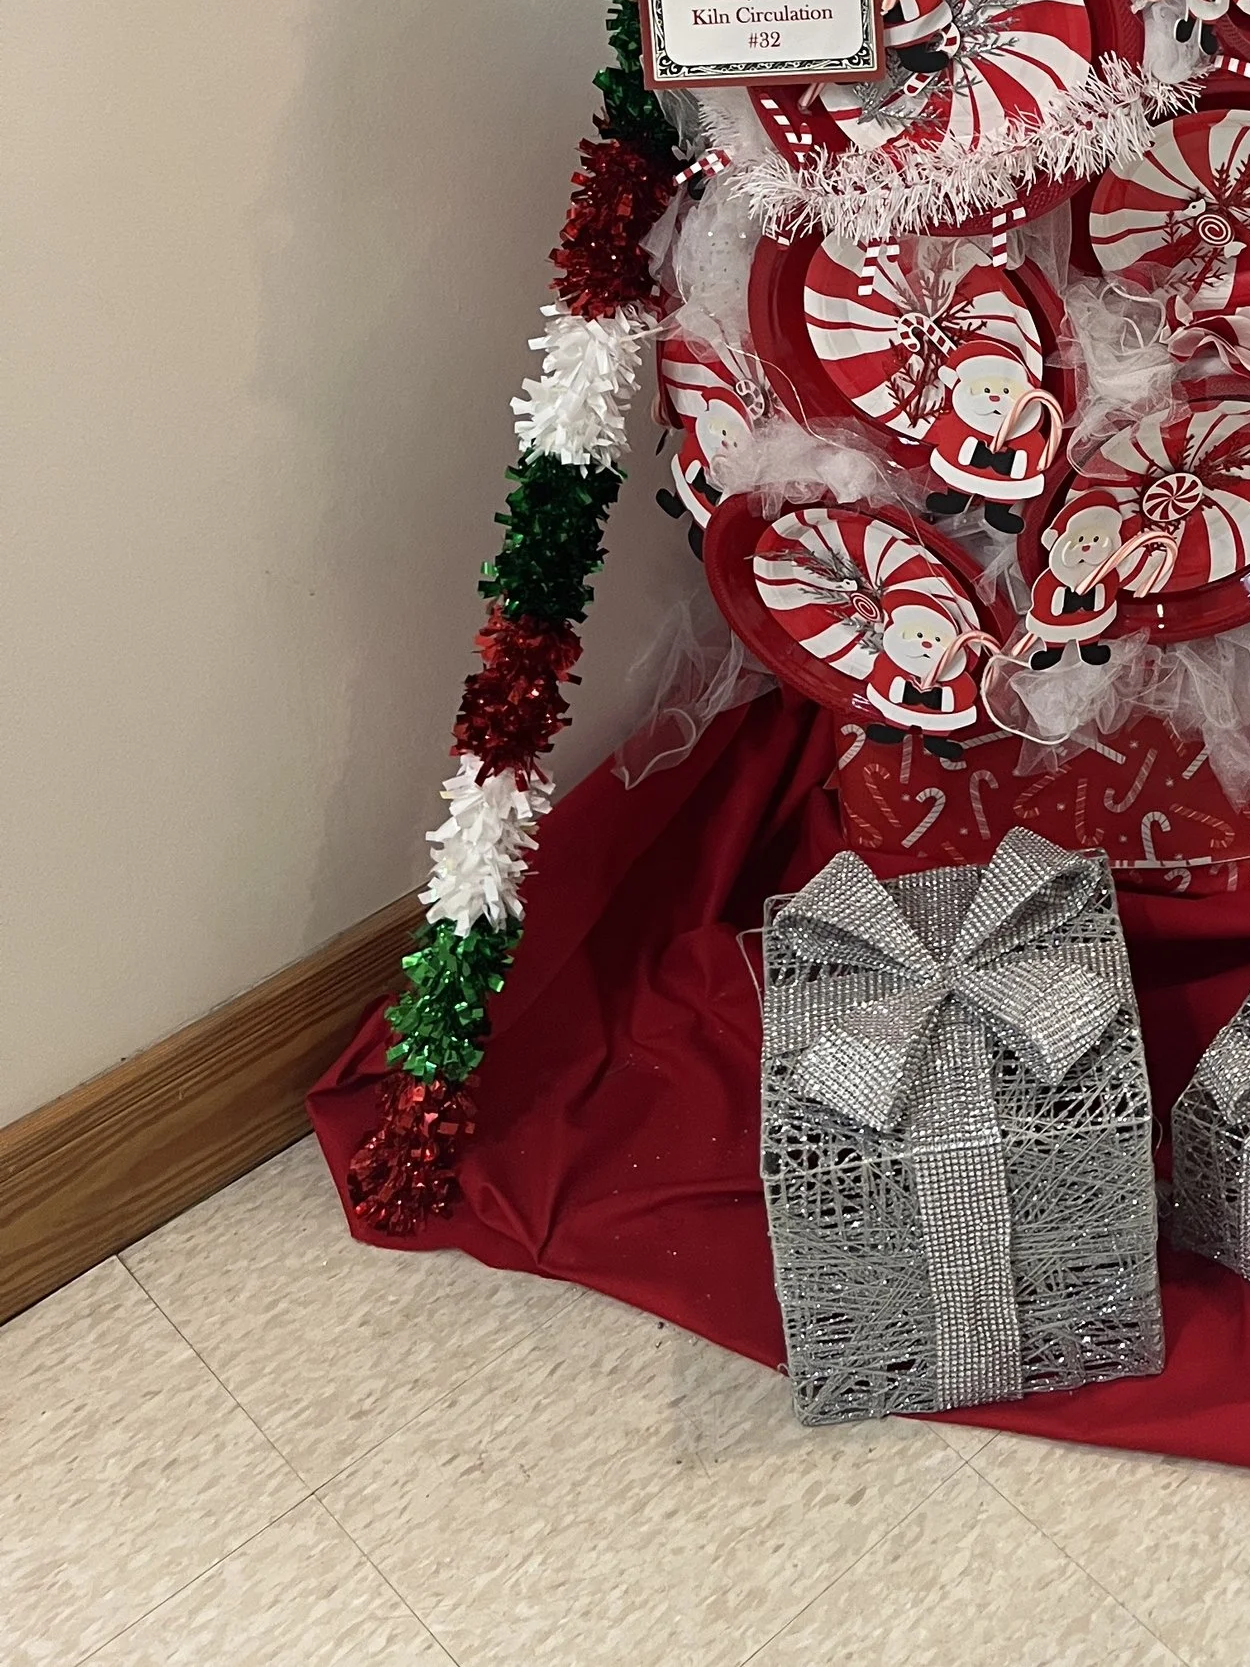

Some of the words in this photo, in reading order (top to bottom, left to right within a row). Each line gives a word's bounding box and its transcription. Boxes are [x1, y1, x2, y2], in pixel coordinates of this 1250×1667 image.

[692, 8, 730, 26] Kiln
[736, 5, 833, 24] Circulation
[748, 31, 781, 49] #32
